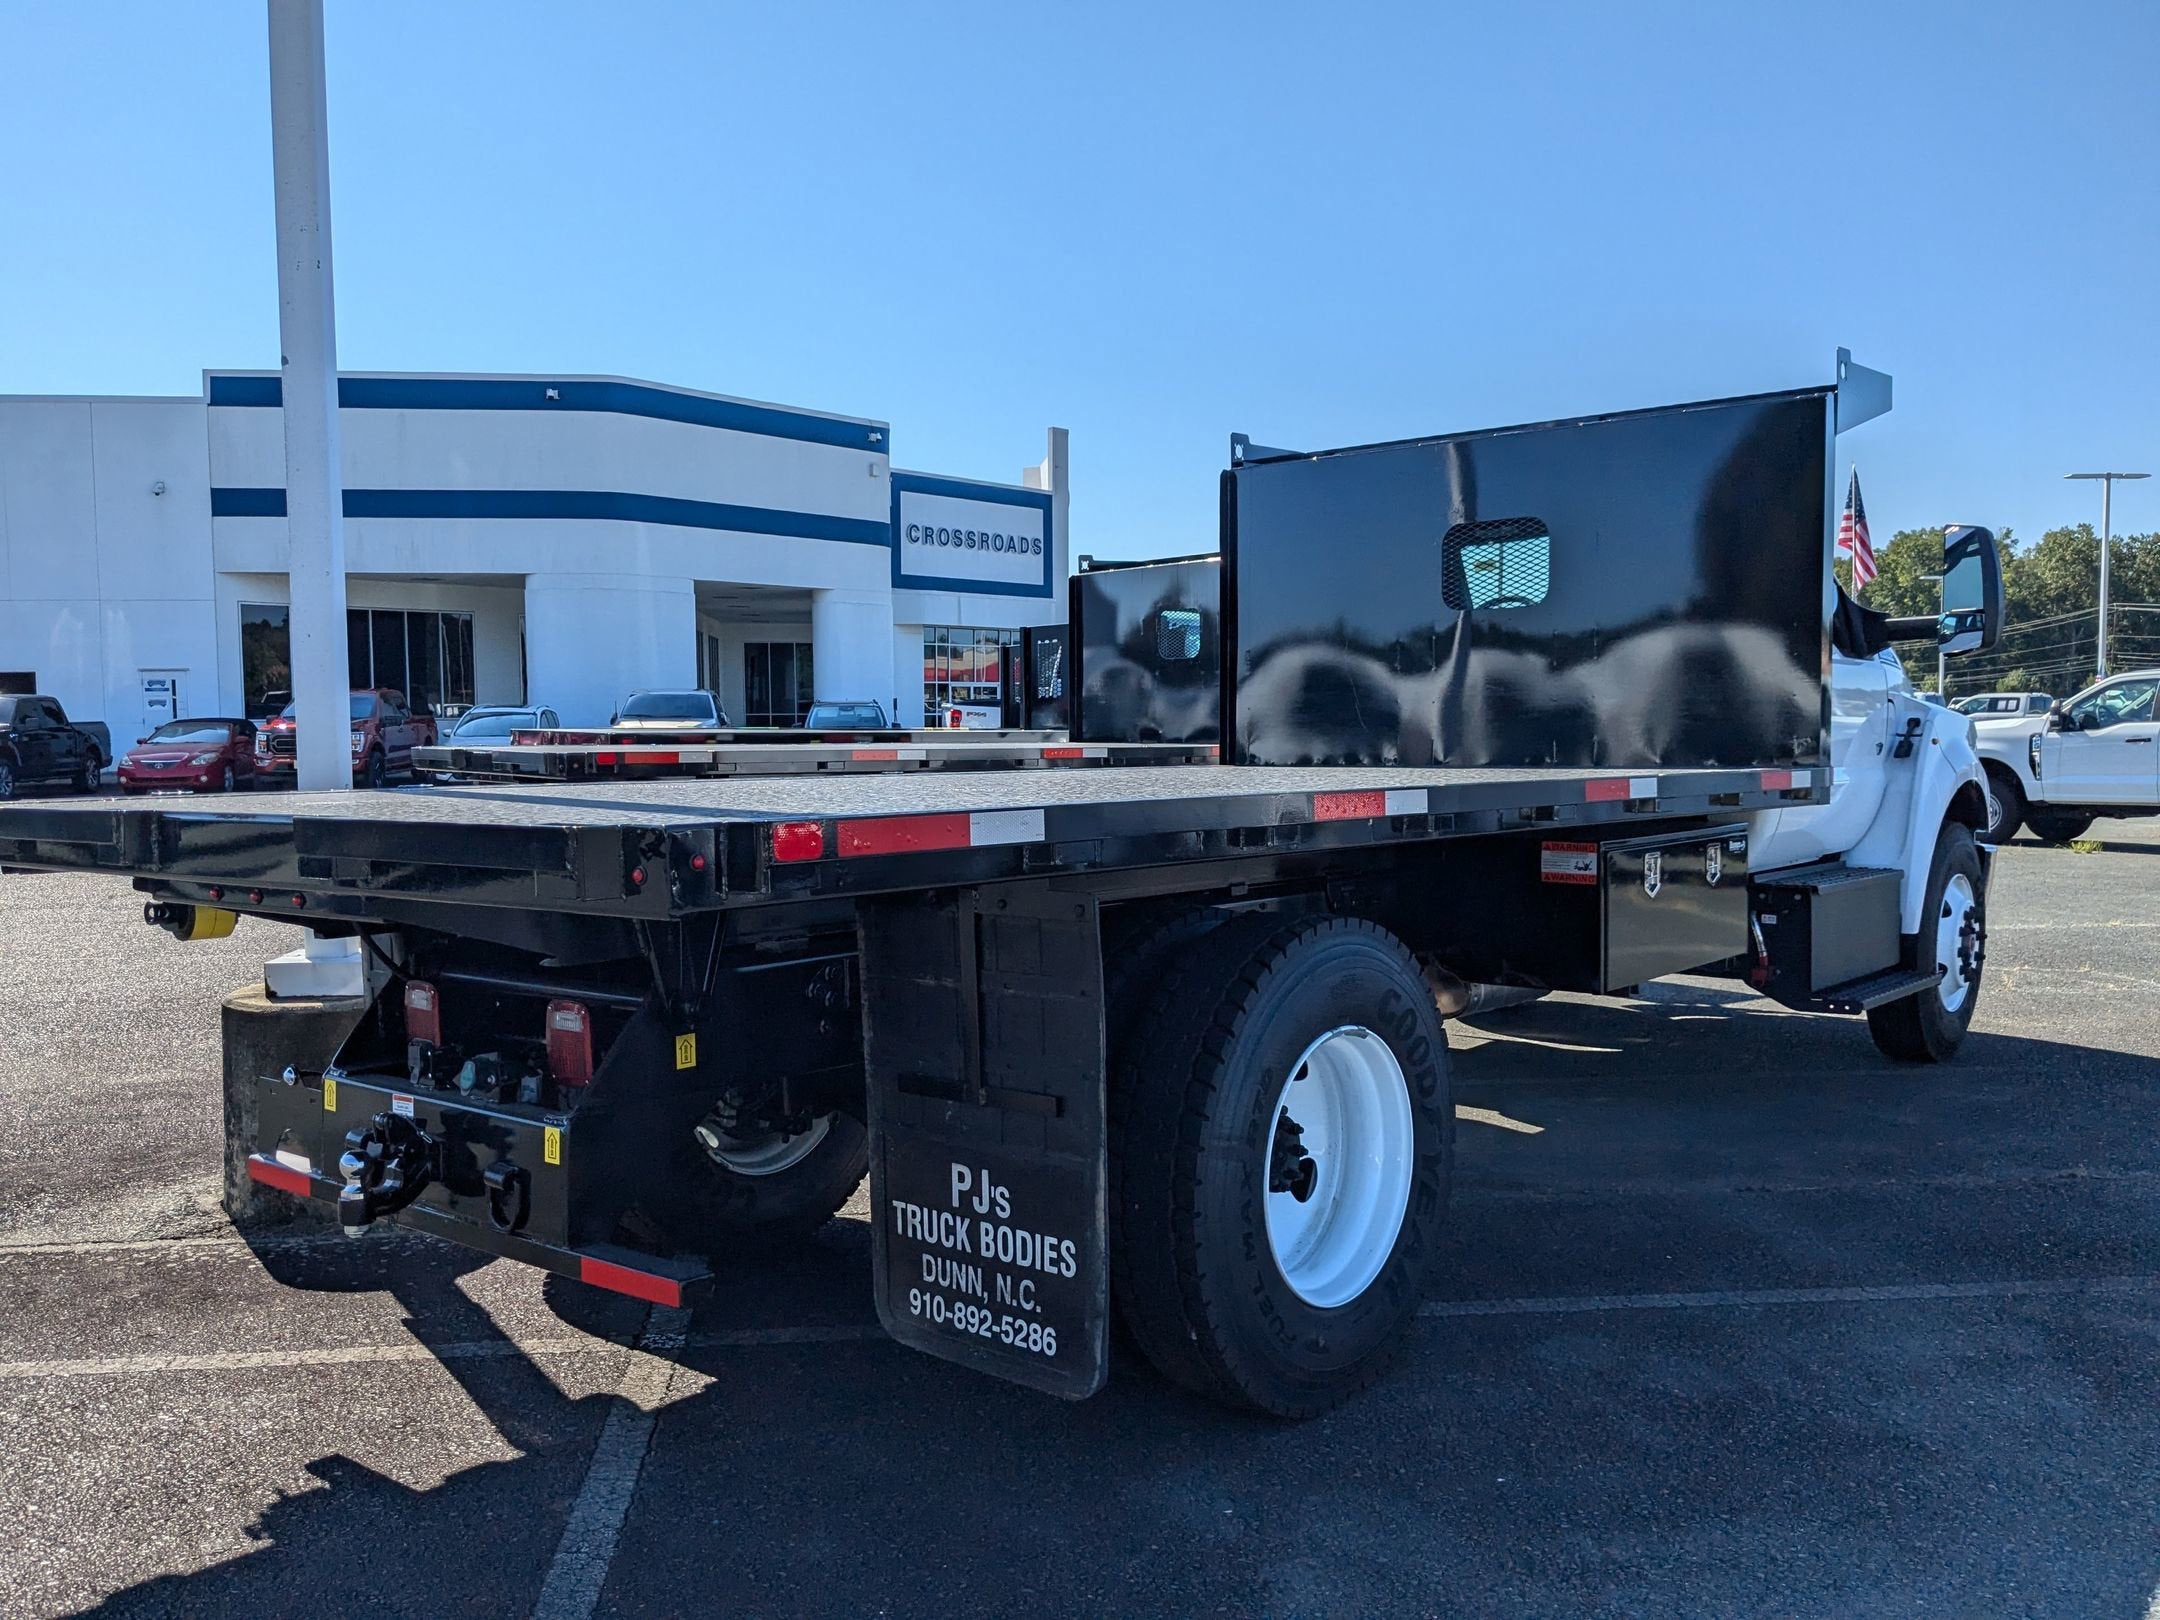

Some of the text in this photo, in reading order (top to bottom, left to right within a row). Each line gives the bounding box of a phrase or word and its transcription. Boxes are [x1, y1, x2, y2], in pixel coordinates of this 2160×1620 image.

[906, 523, 1042, 555] CROSSROADS
[951, 1162, 1011, 1219] PJ's
[892, 1199, 1077, 1278] TRUCK BODIES
[922, 1253, 1042, 1313] DUNN, N.C.
[909, 1288, 1057, 1356] 910-892-5286
